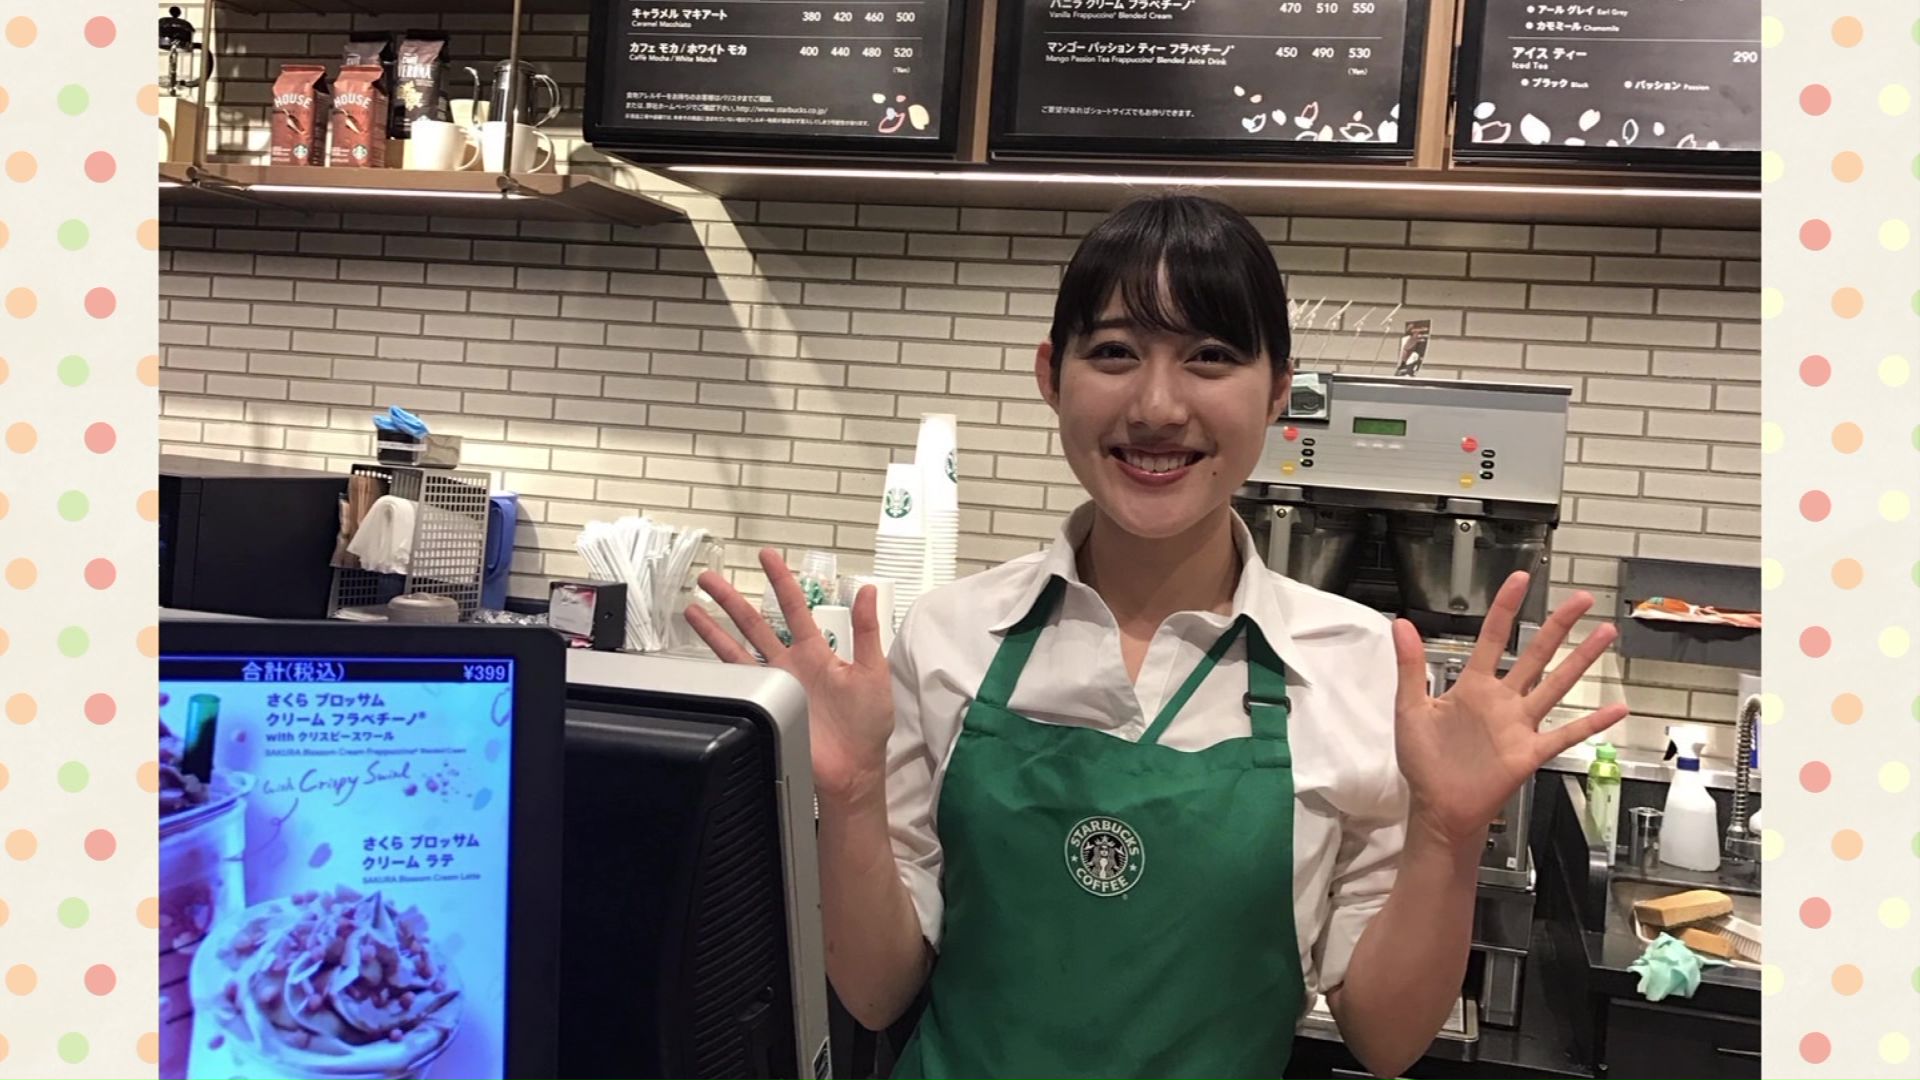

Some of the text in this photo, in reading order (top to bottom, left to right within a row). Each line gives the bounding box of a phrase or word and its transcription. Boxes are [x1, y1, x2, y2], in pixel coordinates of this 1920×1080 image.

[632, 8, 728, 20] キャラメル マキアート
[1280, 2, 1375, 13] 470 510 550
[802, 11, 916, 22] 380 420 460 500
[629, 42, 656, 53] カフェ
[728, 44, 748, 56] モカ
[799, 46, 913, 58] 400 440 480 520
[1047, 42, 1086, 54] マンゴー
[1138, 43, 1166, 54] ティー
[1275, 46, 1371, 59] 450 490 530
[1512, 46, 1588, 60] アイス ティー
[1732, 51, 1759, 63] 290
[274, 93, 312, 108] HOUSE
[334, 93, 373, 109] HOUSE
[241, 662, 345, 682] 合計(税込)
[463, 665, 506, 681] ¥399
[266, 692, 385, 708] さくら ブロッサム
[265, 712, 326, 727] クリーム
[265, 731, 295, 742] with
[299, 767, 360, 807] Crispy
[362, 833, 480, 852] さくら ブロッサム
[1070, 820, 1140, 856] STARBUCKS
[362, 853, 454, 871] クリーム ラテ
[1076, 867, 1129, 892] COFFEE
